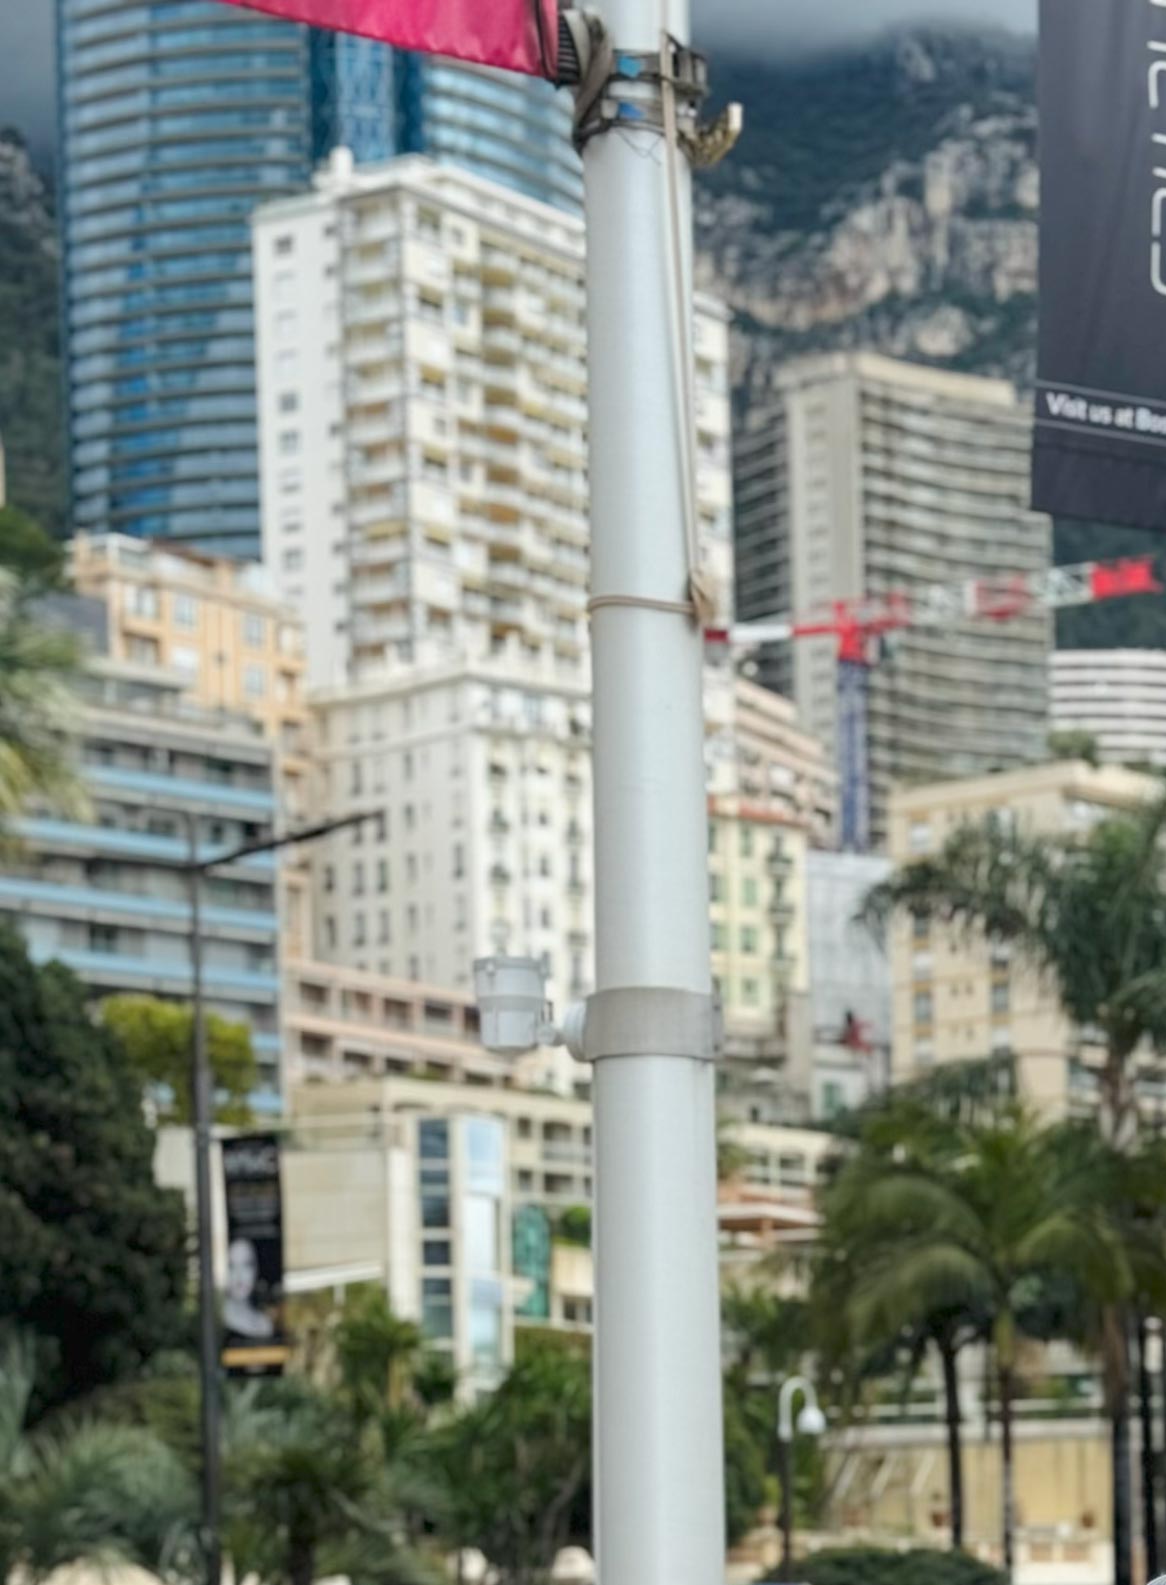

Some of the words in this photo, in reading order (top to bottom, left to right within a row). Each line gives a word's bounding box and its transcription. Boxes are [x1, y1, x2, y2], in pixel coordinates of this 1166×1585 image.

[1045, 391, 1088, 421] Visit
[1088, 404, 1113, 425] us
[1114, 406, 1134, 429] at
